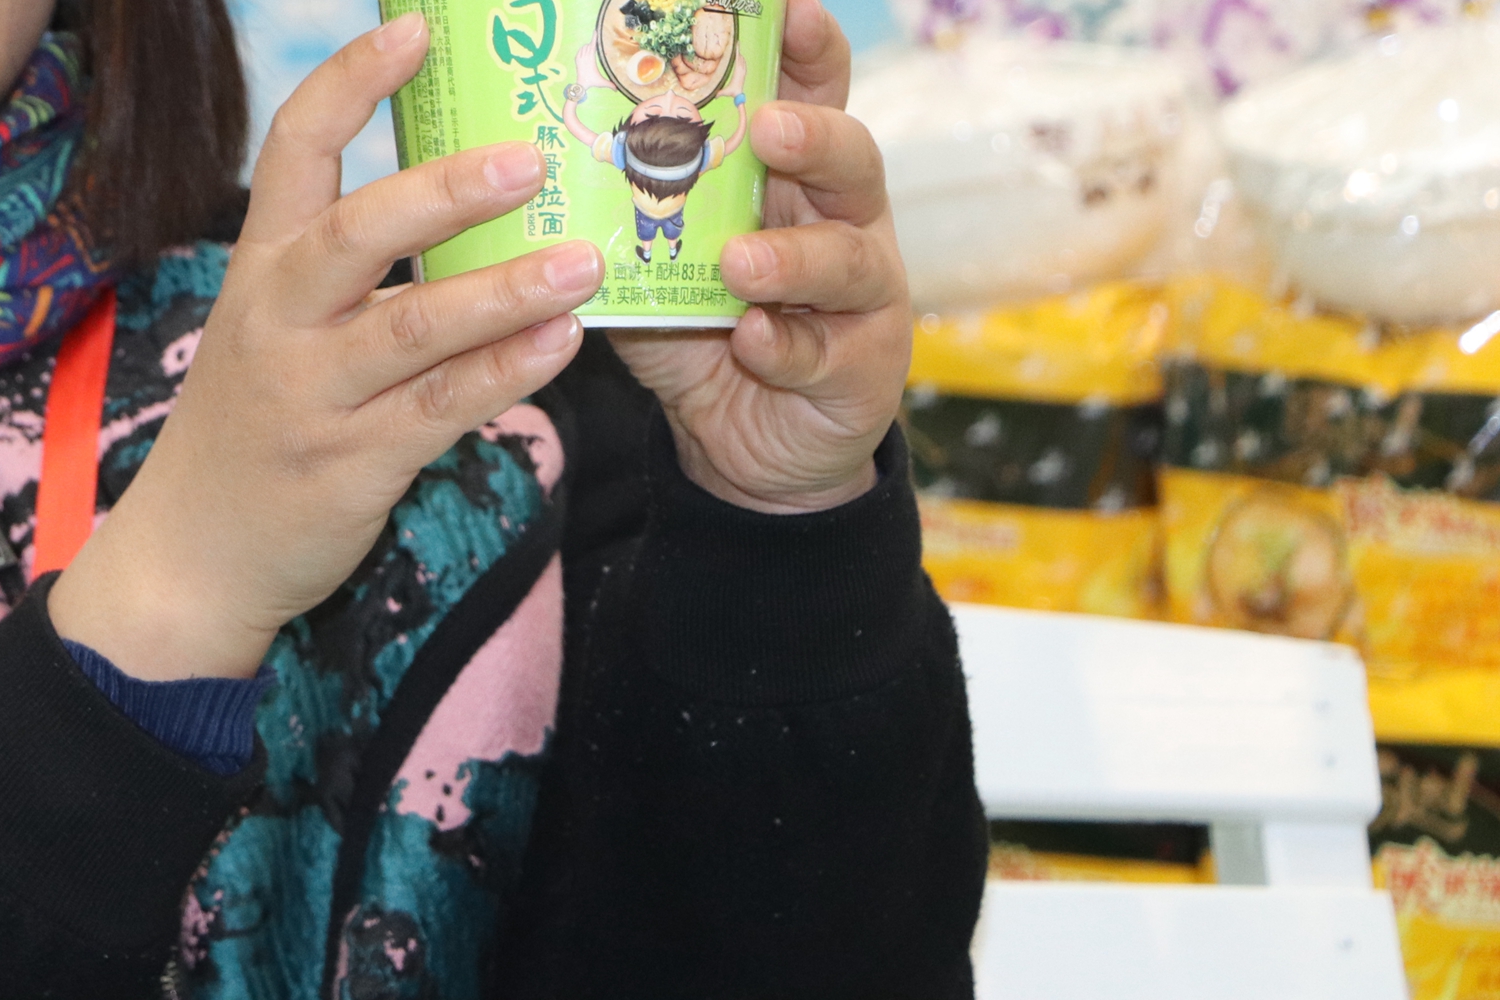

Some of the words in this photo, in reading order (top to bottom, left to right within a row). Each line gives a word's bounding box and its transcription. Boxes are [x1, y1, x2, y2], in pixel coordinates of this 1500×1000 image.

[534, 126, 566, 236] 豚骨拉面
[527, 213, 536, 236] PORK
